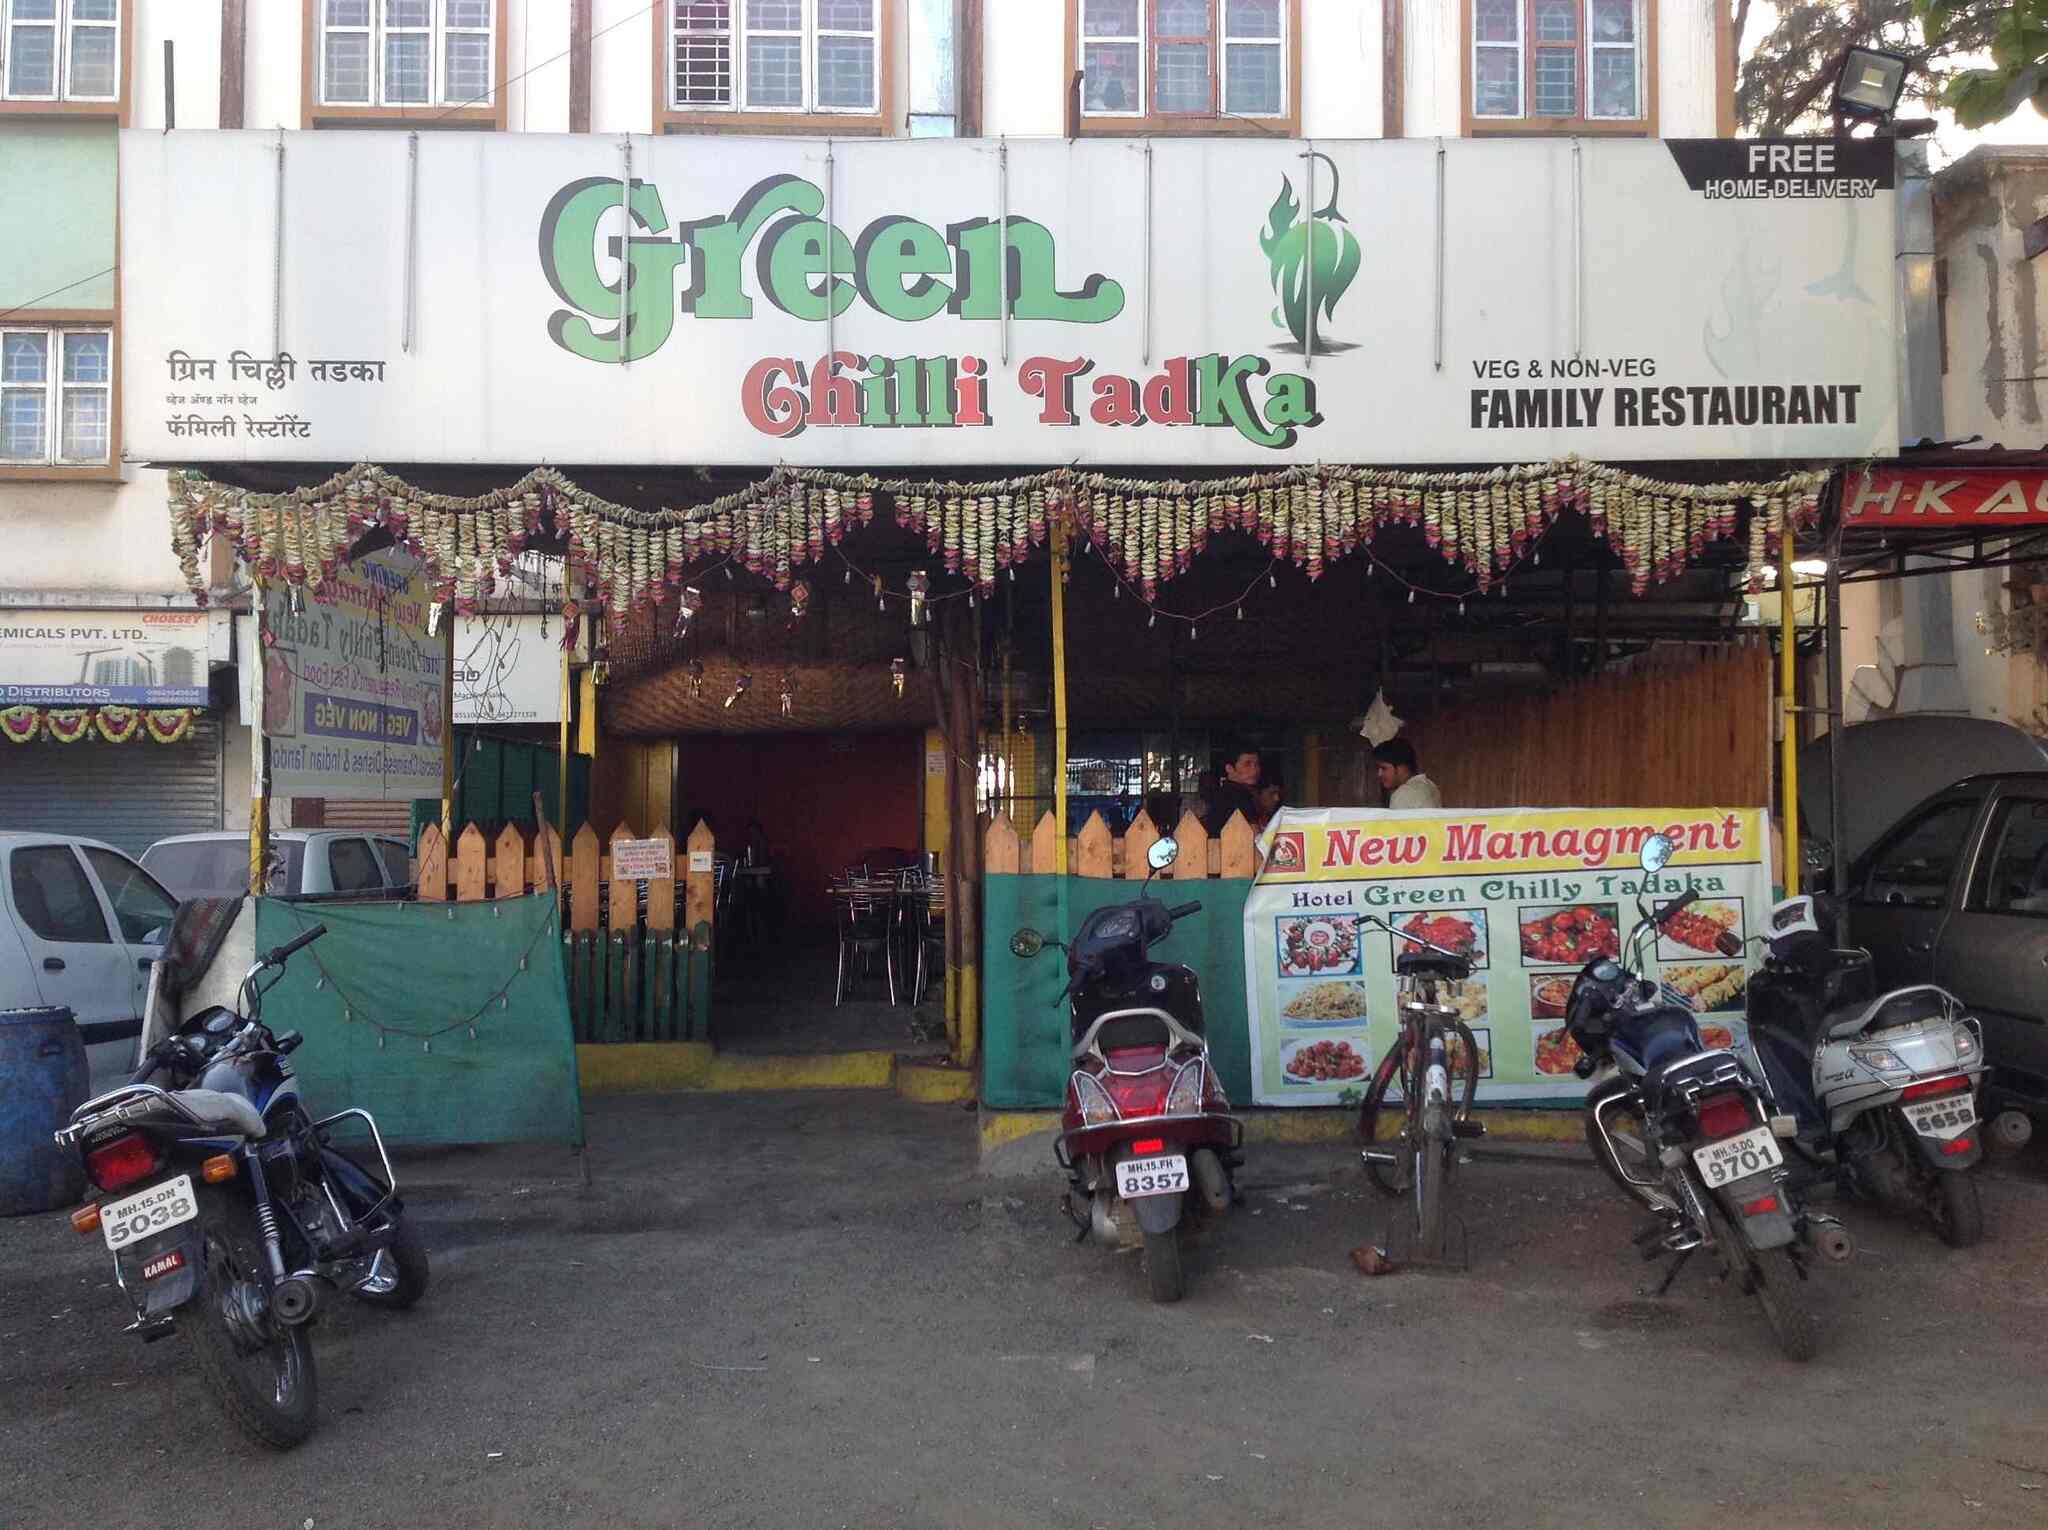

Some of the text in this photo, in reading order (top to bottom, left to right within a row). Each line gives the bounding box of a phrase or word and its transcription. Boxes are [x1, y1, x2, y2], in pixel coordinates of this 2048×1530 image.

[1749, 144, 1836, 173] FREE
[1703, 178, 1879, 199] HOME DELIVERY
[539, 173, 1126, 364] Green
[166, 349, 387, 391] ग्रिन चिल्ली तडका
[1472, 358, 1657, 379] VEG & NON-VEG
[741, 350, 993, 439] Chilli
[1470, 384, 1862, 429] FAMILY RESTAURANT
[166, 414, 237, 437] फॅमिली
[71, 628, 107, 640] PVT.
[112, 629, 148, 641] LTD.
[142, 612, 202, 625] CHOKSEY
[1322, 813, 1742, 868] New Managment
[1292, 871, 1725, 908] Hotel Green Chilly Tadaka
[1709, 1145, 1774, 1182] 9701
[1125, 1172, 1185, 1193] 8357
[110, 1197, 192, 1244] 5038
[143, 1255, 179, 1279] KAMAL
